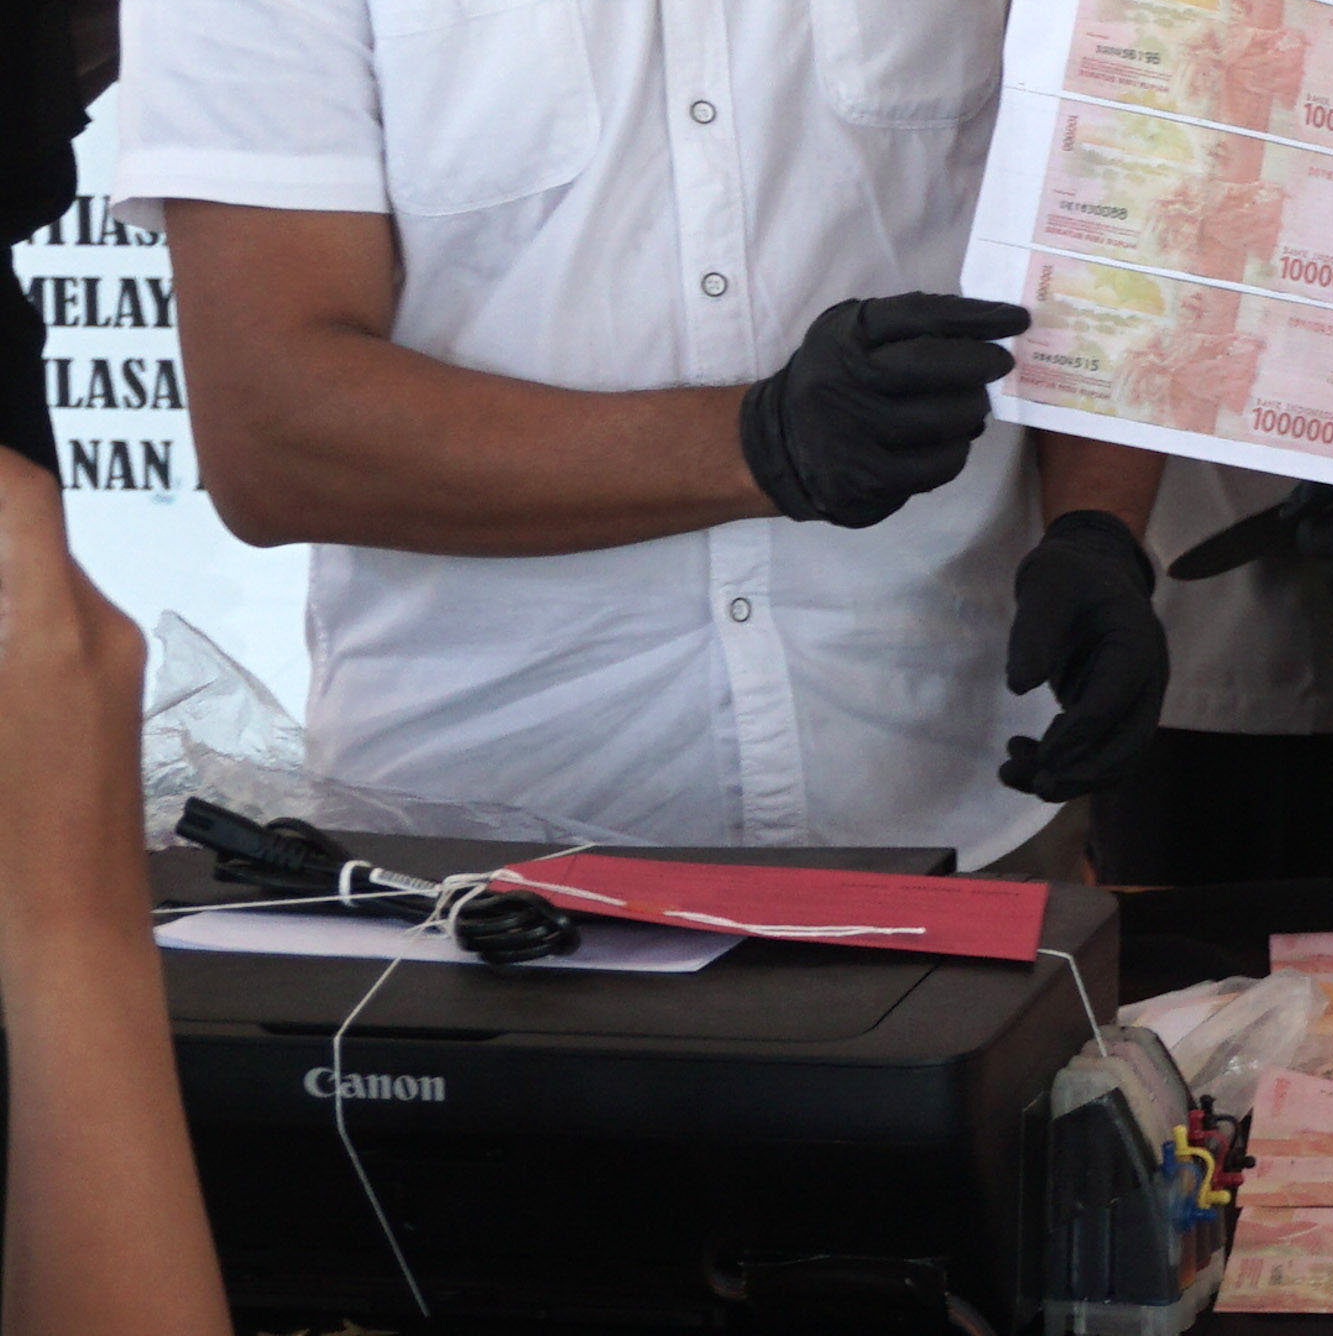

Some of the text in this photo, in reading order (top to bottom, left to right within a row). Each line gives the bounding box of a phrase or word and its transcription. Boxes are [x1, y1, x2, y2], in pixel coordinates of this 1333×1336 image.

[45, 358, 188, 410] LASA
[60, 439, 174, 491] NAN
[304, 1067, 446, 1102] Canon
